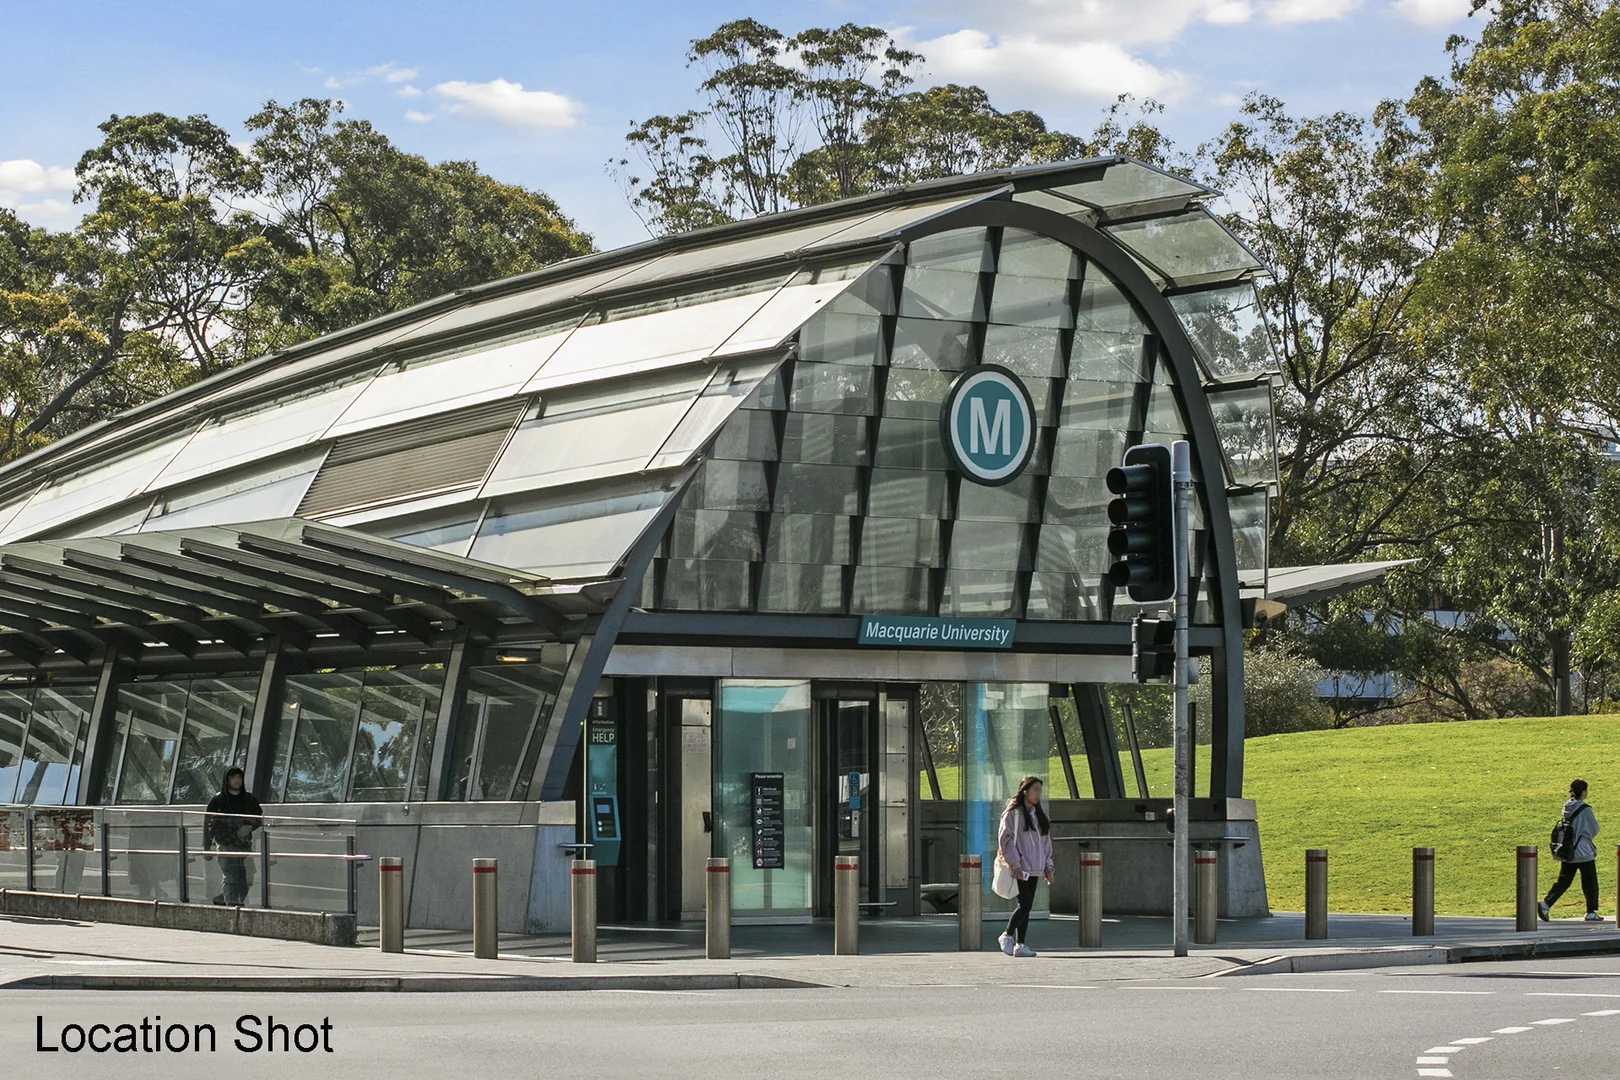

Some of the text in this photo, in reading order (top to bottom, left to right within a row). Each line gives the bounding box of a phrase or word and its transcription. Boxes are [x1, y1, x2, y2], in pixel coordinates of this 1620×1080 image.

[970, 397, 1011, 455] M
[866, 621, 1010, 645] Macquarie University
[592, 733, 615, 743] HELP
